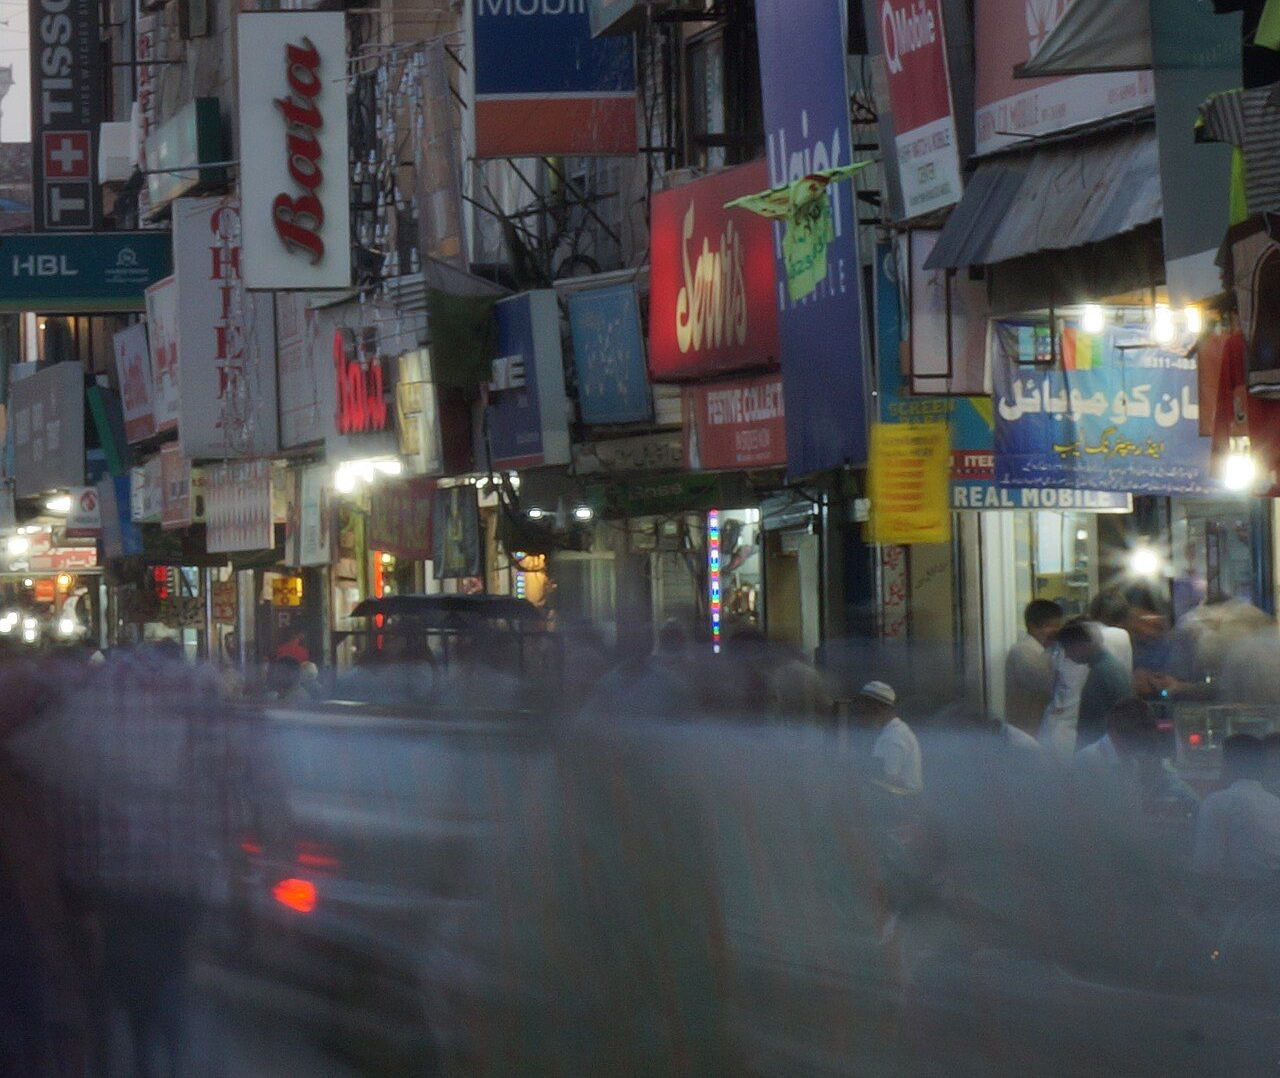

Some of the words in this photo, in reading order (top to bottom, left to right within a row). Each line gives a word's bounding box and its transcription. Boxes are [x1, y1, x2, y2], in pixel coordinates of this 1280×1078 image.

[881, 0, 936, 75] QMobile
[272, 35, 324, 266] Bata
[12, 254, 80, 277] HBL
[998, 379, 1109, 422] موبائل
[953, 485, 1015, 507] REAL
[1021, 487, 1113, 509] MOBILE
